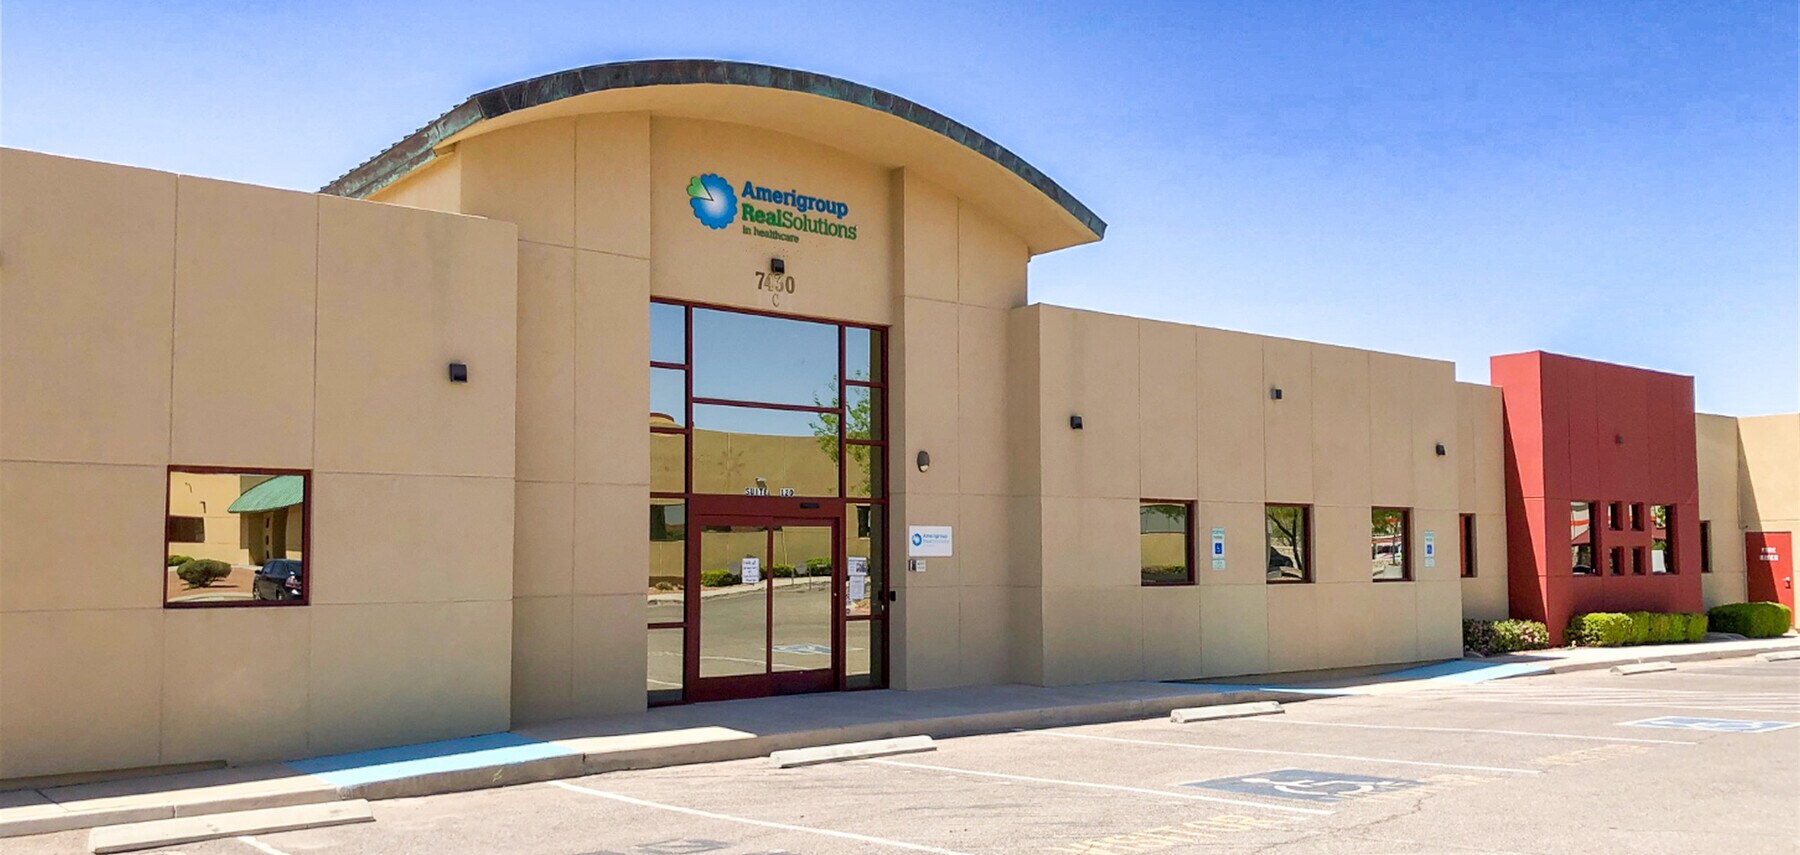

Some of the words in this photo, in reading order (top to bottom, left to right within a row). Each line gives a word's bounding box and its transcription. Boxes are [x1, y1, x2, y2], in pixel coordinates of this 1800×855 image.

[741, 180, 848, 219] Amerigroup
[741, 202, 858, 240] RealSolutions
[742, 225, 752, 235] in
[753, 226, 800, 243] healthcare
[755, 271, 796, 294] 7430
[772, 293, 780, 307] C
[745, 487, 768, 496] SUITE
